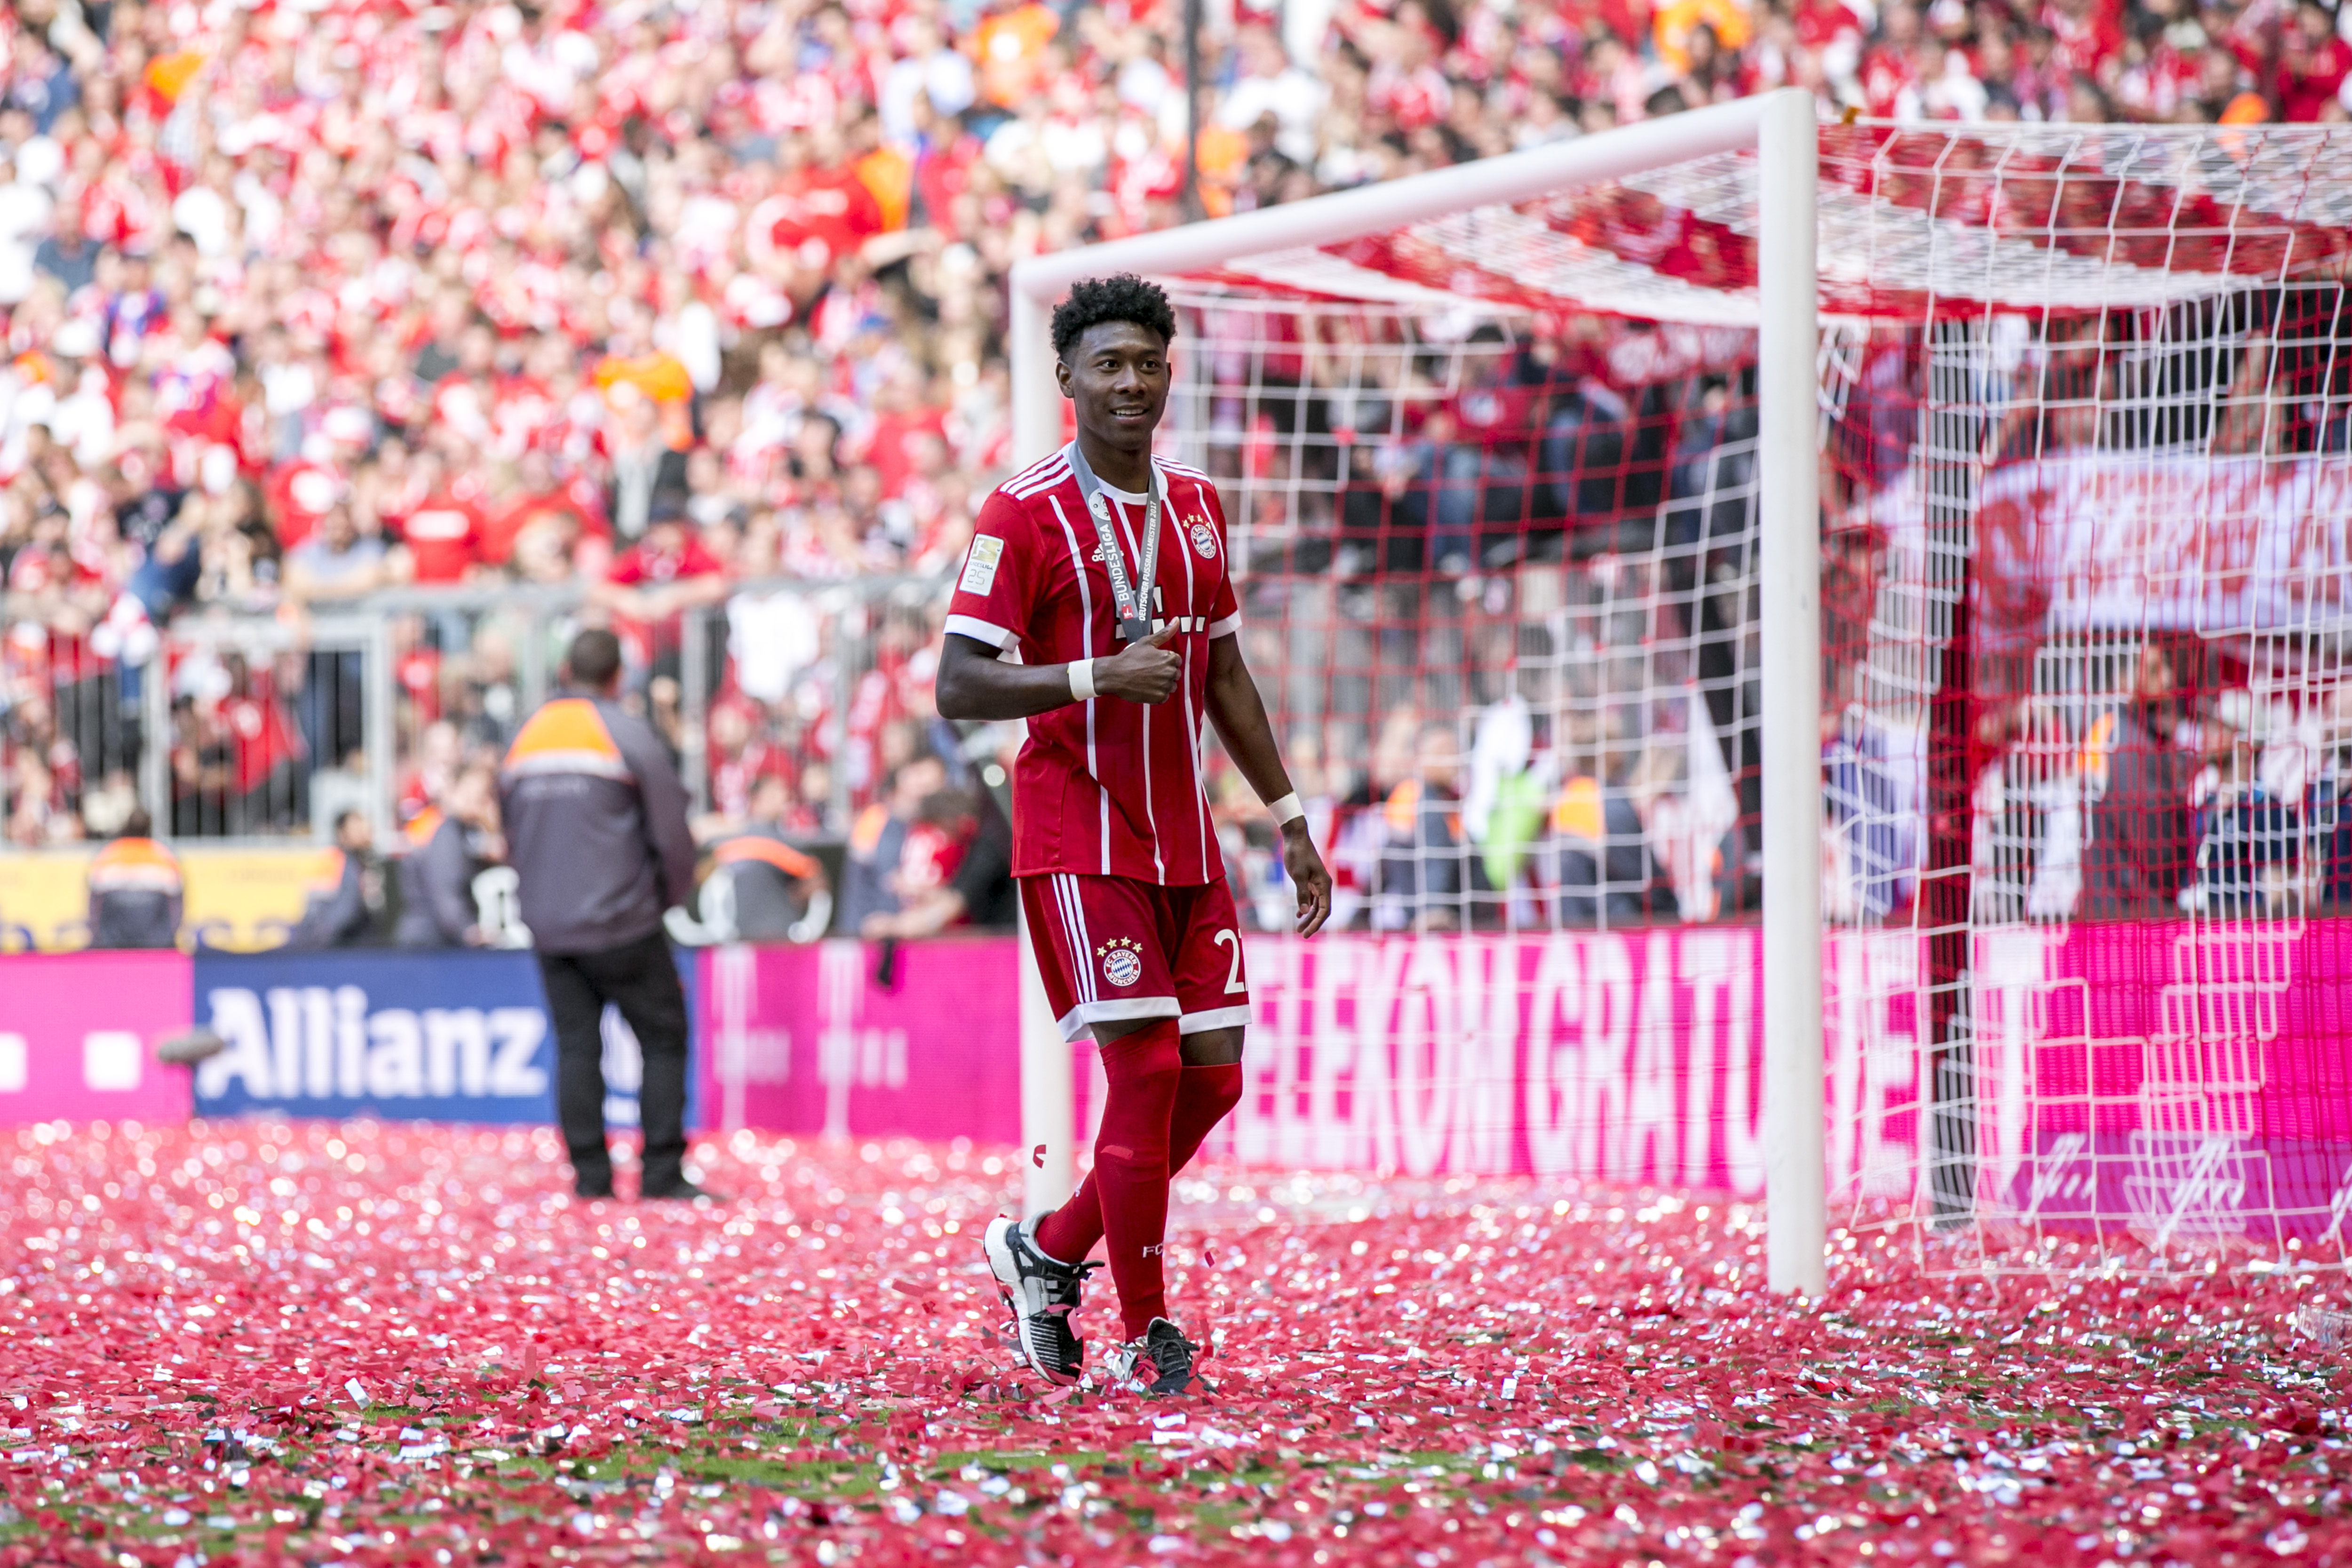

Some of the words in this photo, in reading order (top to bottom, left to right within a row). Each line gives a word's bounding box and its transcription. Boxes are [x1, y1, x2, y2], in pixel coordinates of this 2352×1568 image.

[1099, 524, 1130, 602] BUNDESLIGA
[1143, 518, 1157, 581] FUSSBALLMEISTER
[1139, 581, 1149, 621] DEUTSCHER
[1106, 958, 1113, 968] FC
[1111, 951, 1137, 965] BAYERN
[1214, 928, 1248, 995] 2
[196, 986, 548, 1099] Allianz
[1204, 934, 1518, 1174] ELEKOM
